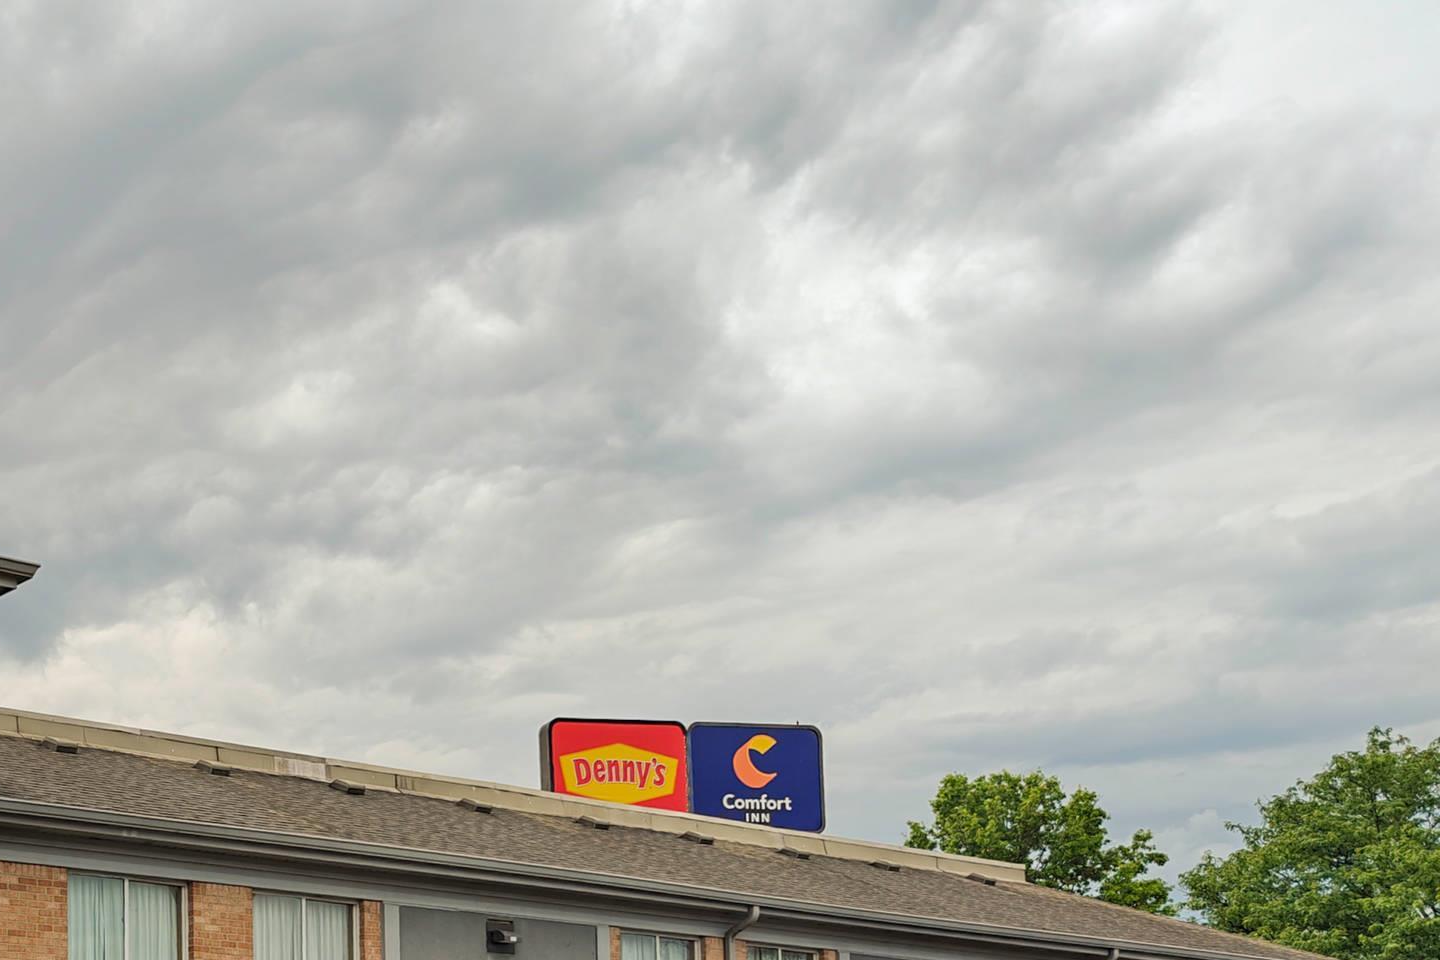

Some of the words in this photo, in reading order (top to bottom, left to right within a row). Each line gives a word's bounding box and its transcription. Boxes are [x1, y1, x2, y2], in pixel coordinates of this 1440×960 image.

[572, 757, 667, 790] Denny's
[722, 793, 792, 811] Comfort
[745, 812, 771, 823] INN
